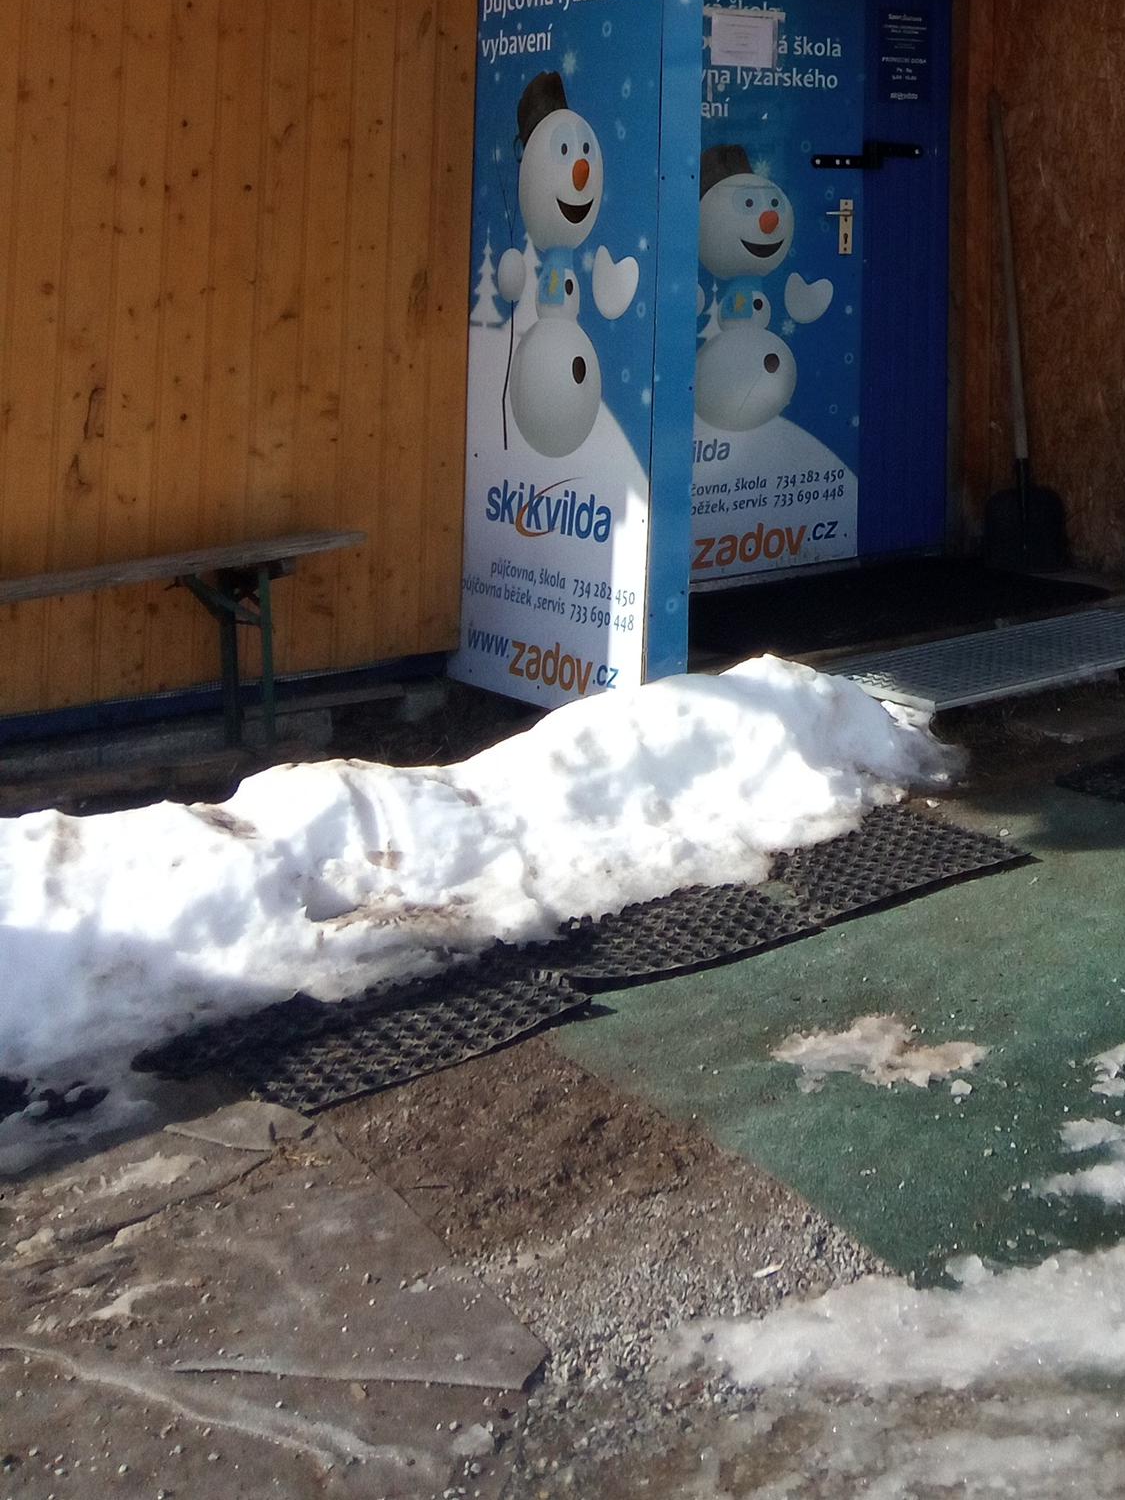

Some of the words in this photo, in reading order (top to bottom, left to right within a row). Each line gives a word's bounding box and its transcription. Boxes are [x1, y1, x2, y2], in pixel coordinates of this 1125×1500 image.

[481, 23, 553, 64] vybavení
[793, 36, 842, 58] škola
[736, 66, 838, 91] lyžařského
[734, 476, 768, 492] škola
[775, 474, 797, 490] 734
[800, 470, 820, 485] 282
[823, 468, 845, 484] 450
[732, 493, 768, 511] servis
[773, 493, 794, 509] 733
[797, 488, 820, 505] 690
[822, 484, 845, 501] 448
[490, 558, 537, 587] půjčovna,
[539, 567, 566, 590] škola
[572, 578, 591, 599] 734
[593, 581, 612, 601] 282
[615, 589, 636, 607] 450
[504, 583, 532, 607] běžek
[569, 603, 588, 624] 733
[590, 605, 611, 629] 690
[613, 613, 635, 633] 448
